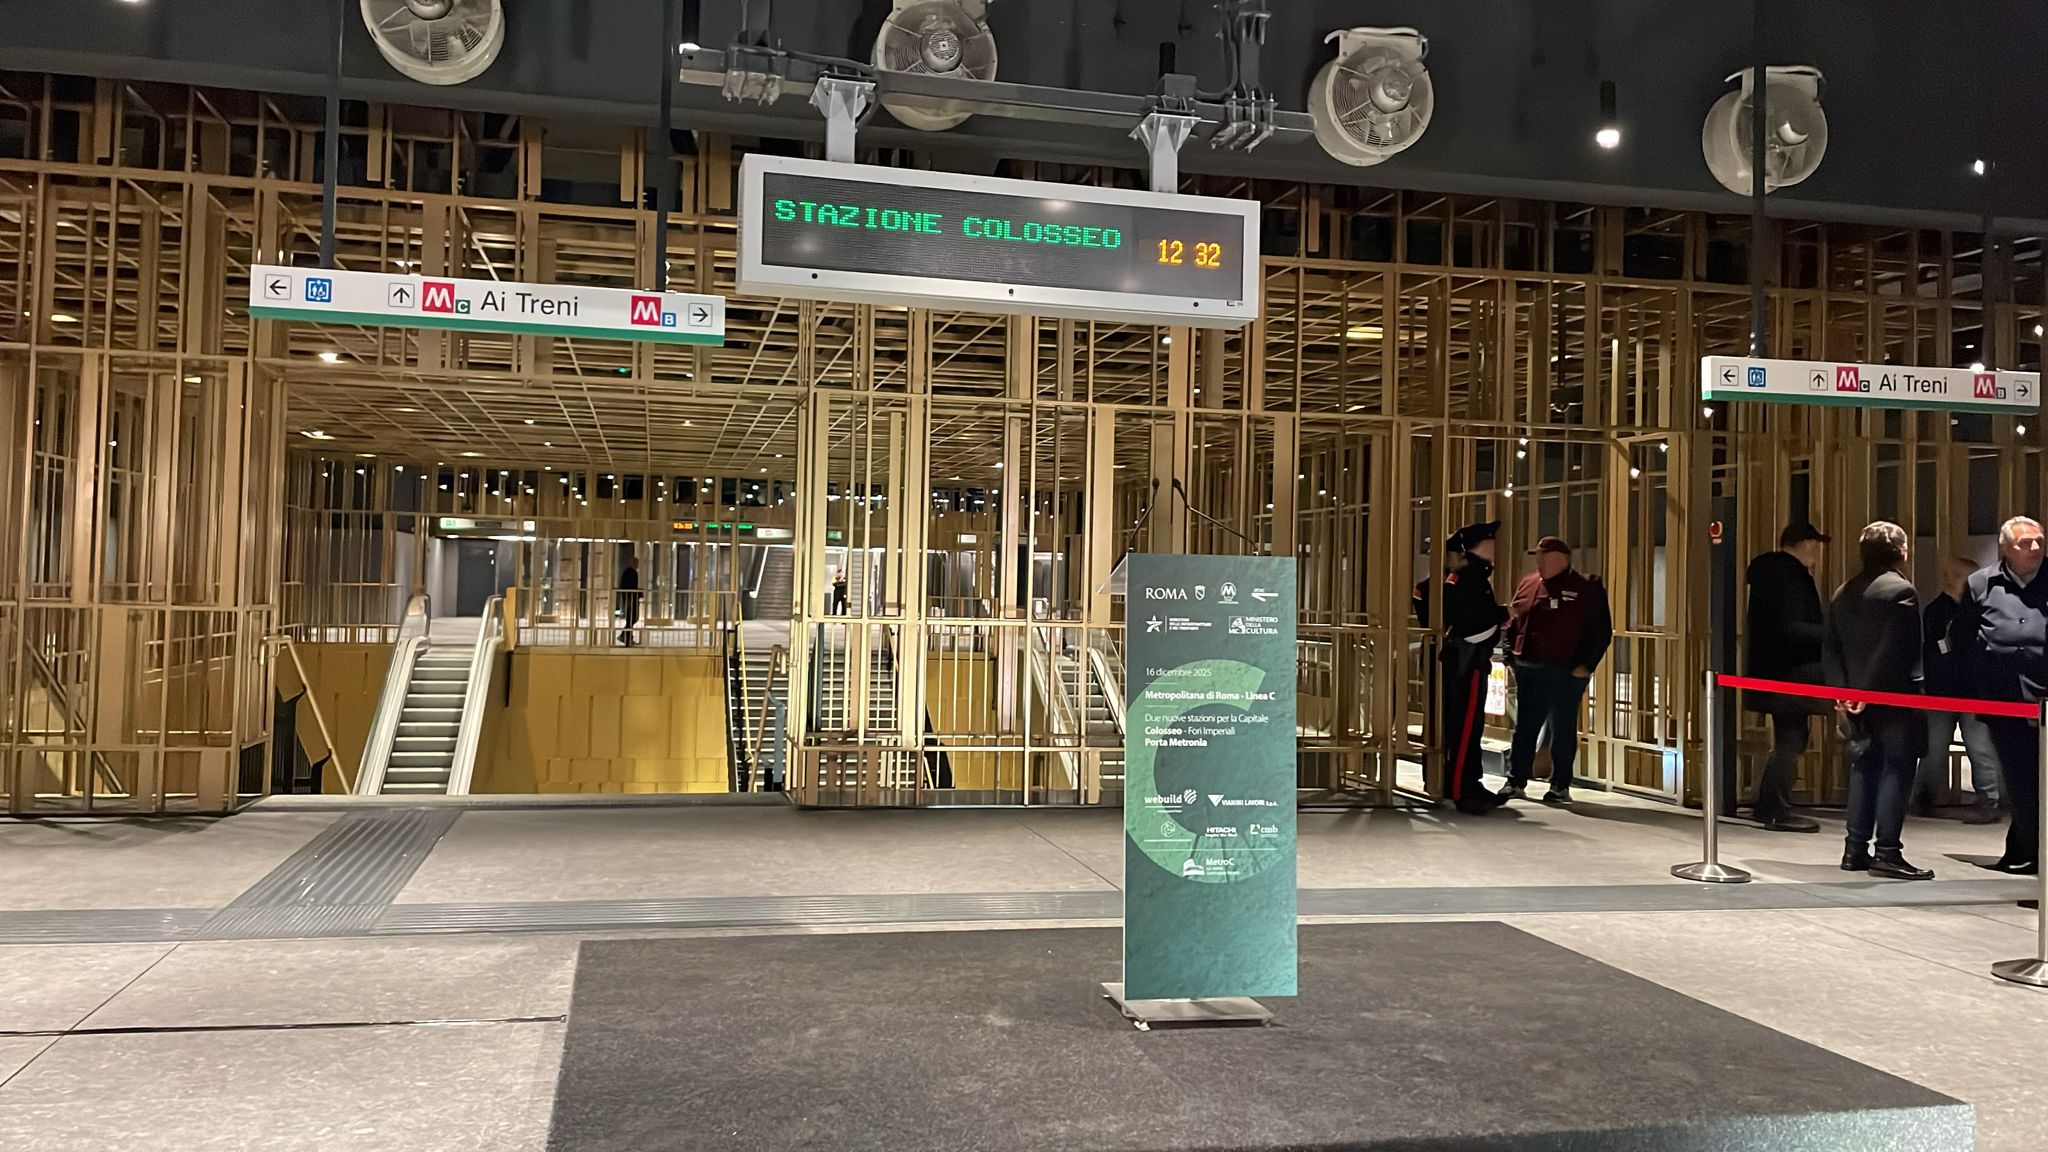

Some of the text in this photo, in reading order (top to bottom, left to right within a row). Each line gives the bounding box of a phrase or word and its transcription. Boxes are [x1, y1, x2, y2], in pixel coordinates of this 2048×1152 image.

[774, 199, 1121, 249] STAZIONE COLOSSEO
[1159, 239, 1221, 267] 12 32
[480, 290, 505, 312] Ai
[515, 292, 578, 316] Treni
[1879, 373, 1897, 391] Ai
[1903, 374, 1947, 394] Treni
[1145, 587, 1188, 600] ROMA
[1245, 627, 1279, 635] CULTURA
[1146, 667, 1212, 677] 16 dicembre 2025
[1144, 690, 1205, 701] Metropolitana
[1206, 690, 1215, 700] di
[1216, 691, 1240, 700] Roma
[1246, 691, 1268, 700] Linea
[1269, 691, 1277, 700] C
[1145, 713, 1161, 722] Due
[1187, 714, 1215, 722] stazioni
[1217, 715, 1229, 724] per
[1231, 713, 1238, 722] la
[1238, 713, 1269, 724] Capitale
[1144, 726, 1183, 735] Colosseo
[1188, 726, 1202, 735] Fori
[1203, 726, 1235, 737] Imperiali
[1144, 737, 1208, 747] Porta Metronia
[1144, 793, 1183, 804] webuild
[1206, 826, 1237, 834] HITACHI
[1260, 824, 1279, 834] cmb
